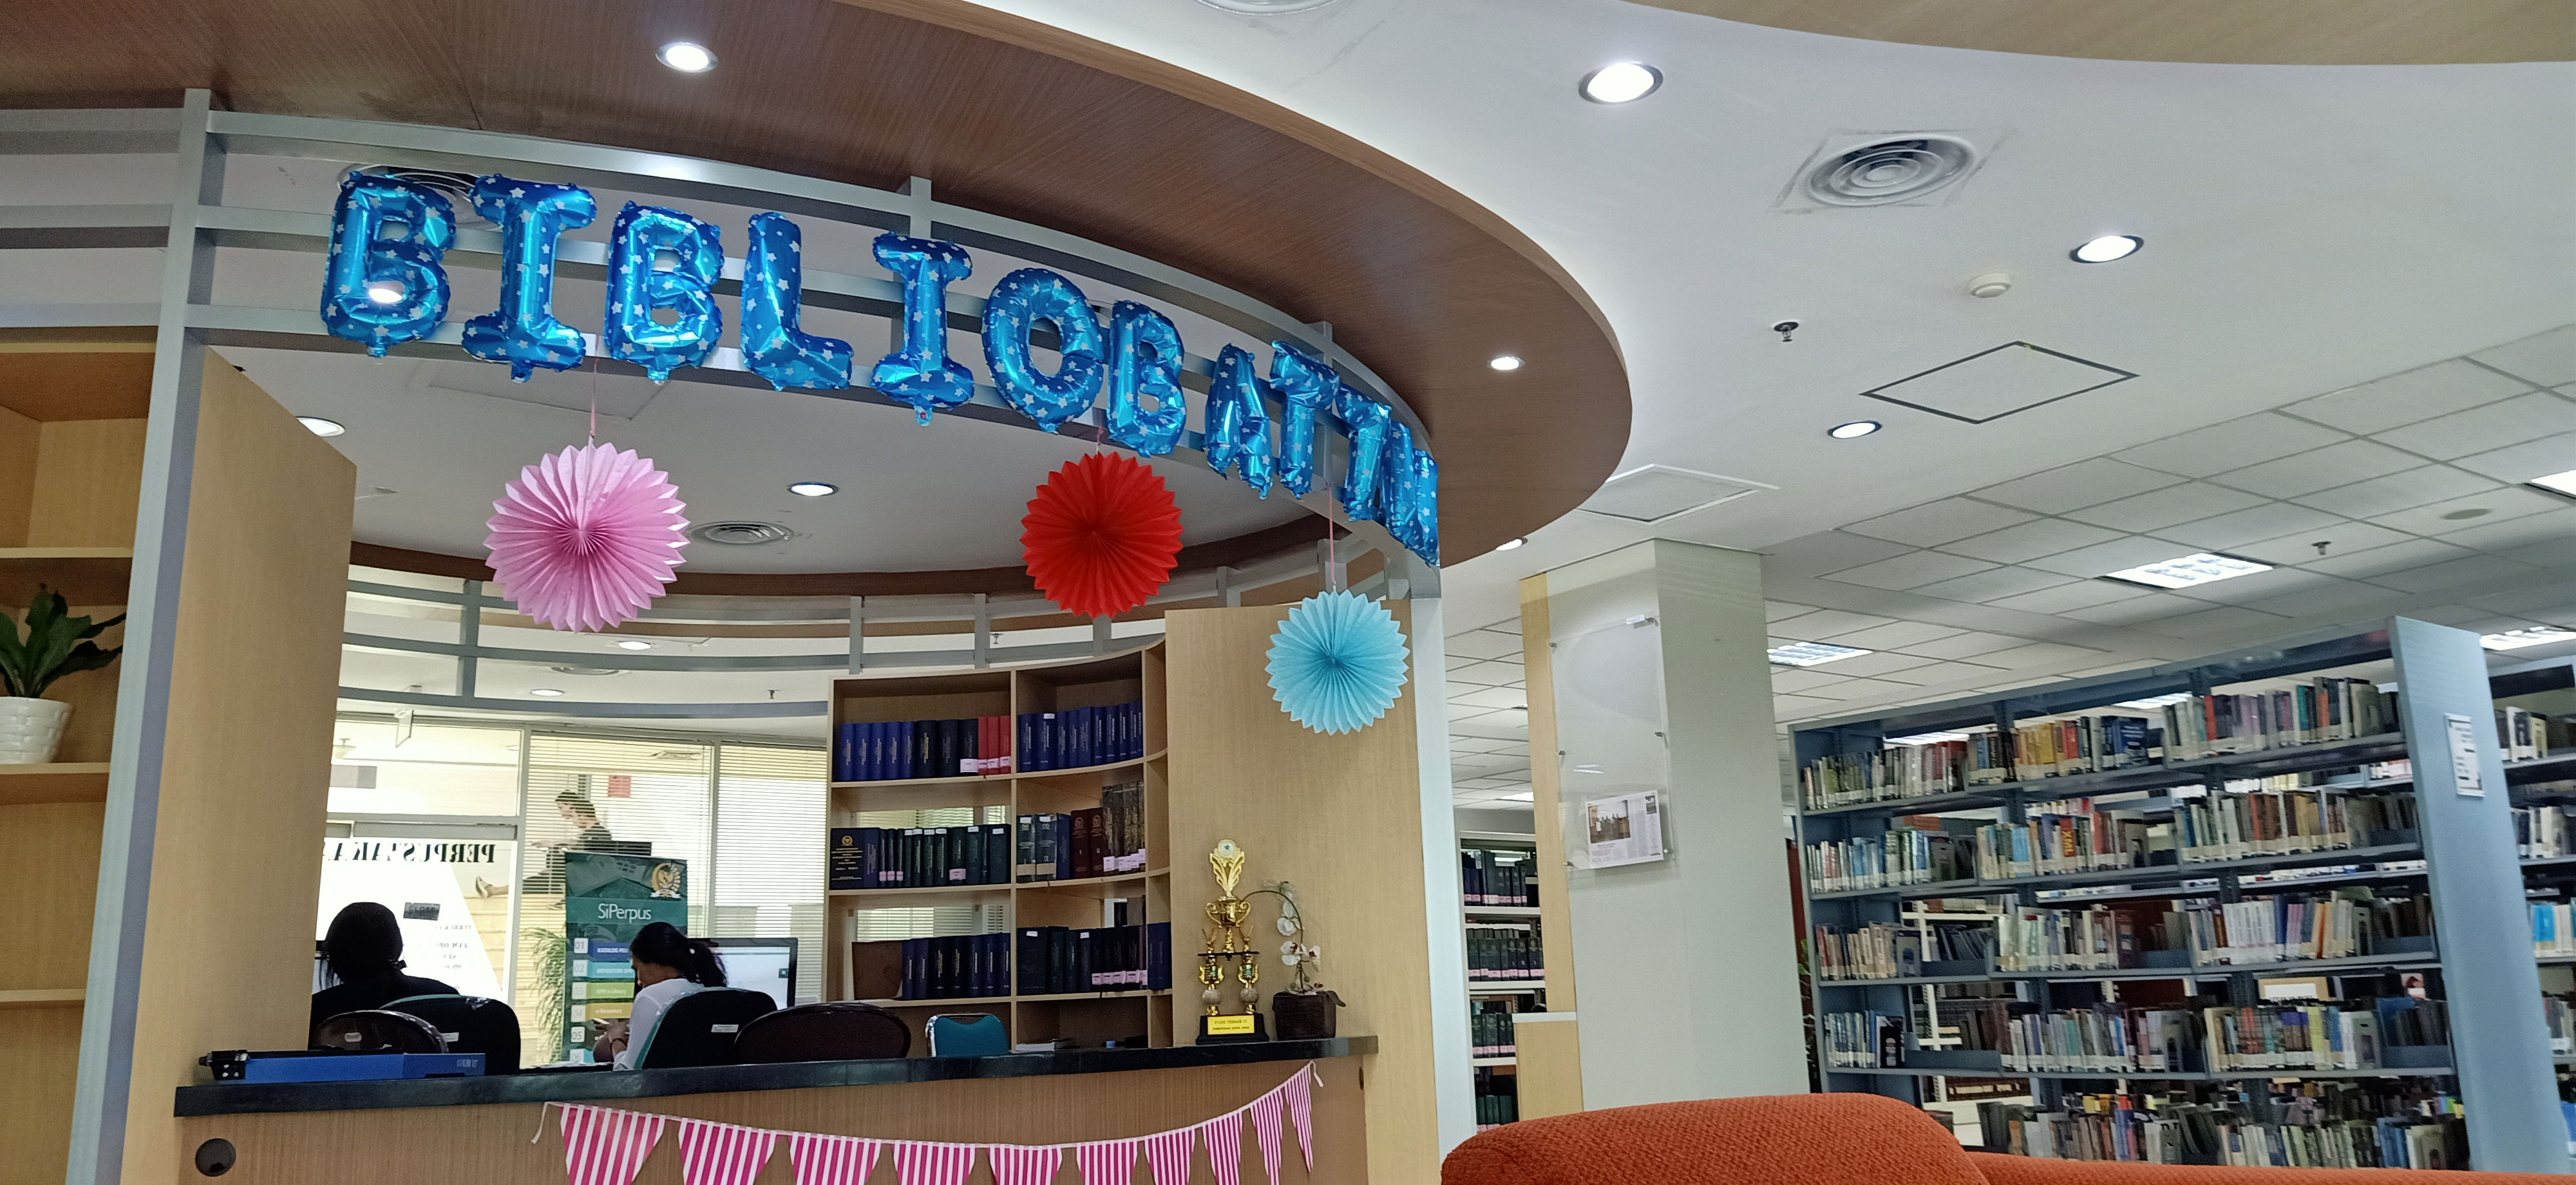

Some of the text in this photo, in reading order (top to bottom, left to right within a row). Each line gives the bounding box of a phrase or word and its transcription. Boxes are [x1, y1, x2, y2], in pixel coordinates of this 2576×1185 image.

[598, 903, 652, 924] SiPerpus
[574, 941, 585, 950] 01
[574, 963, 585, 972] 02
[572, 1031, 582, 1040] 05
